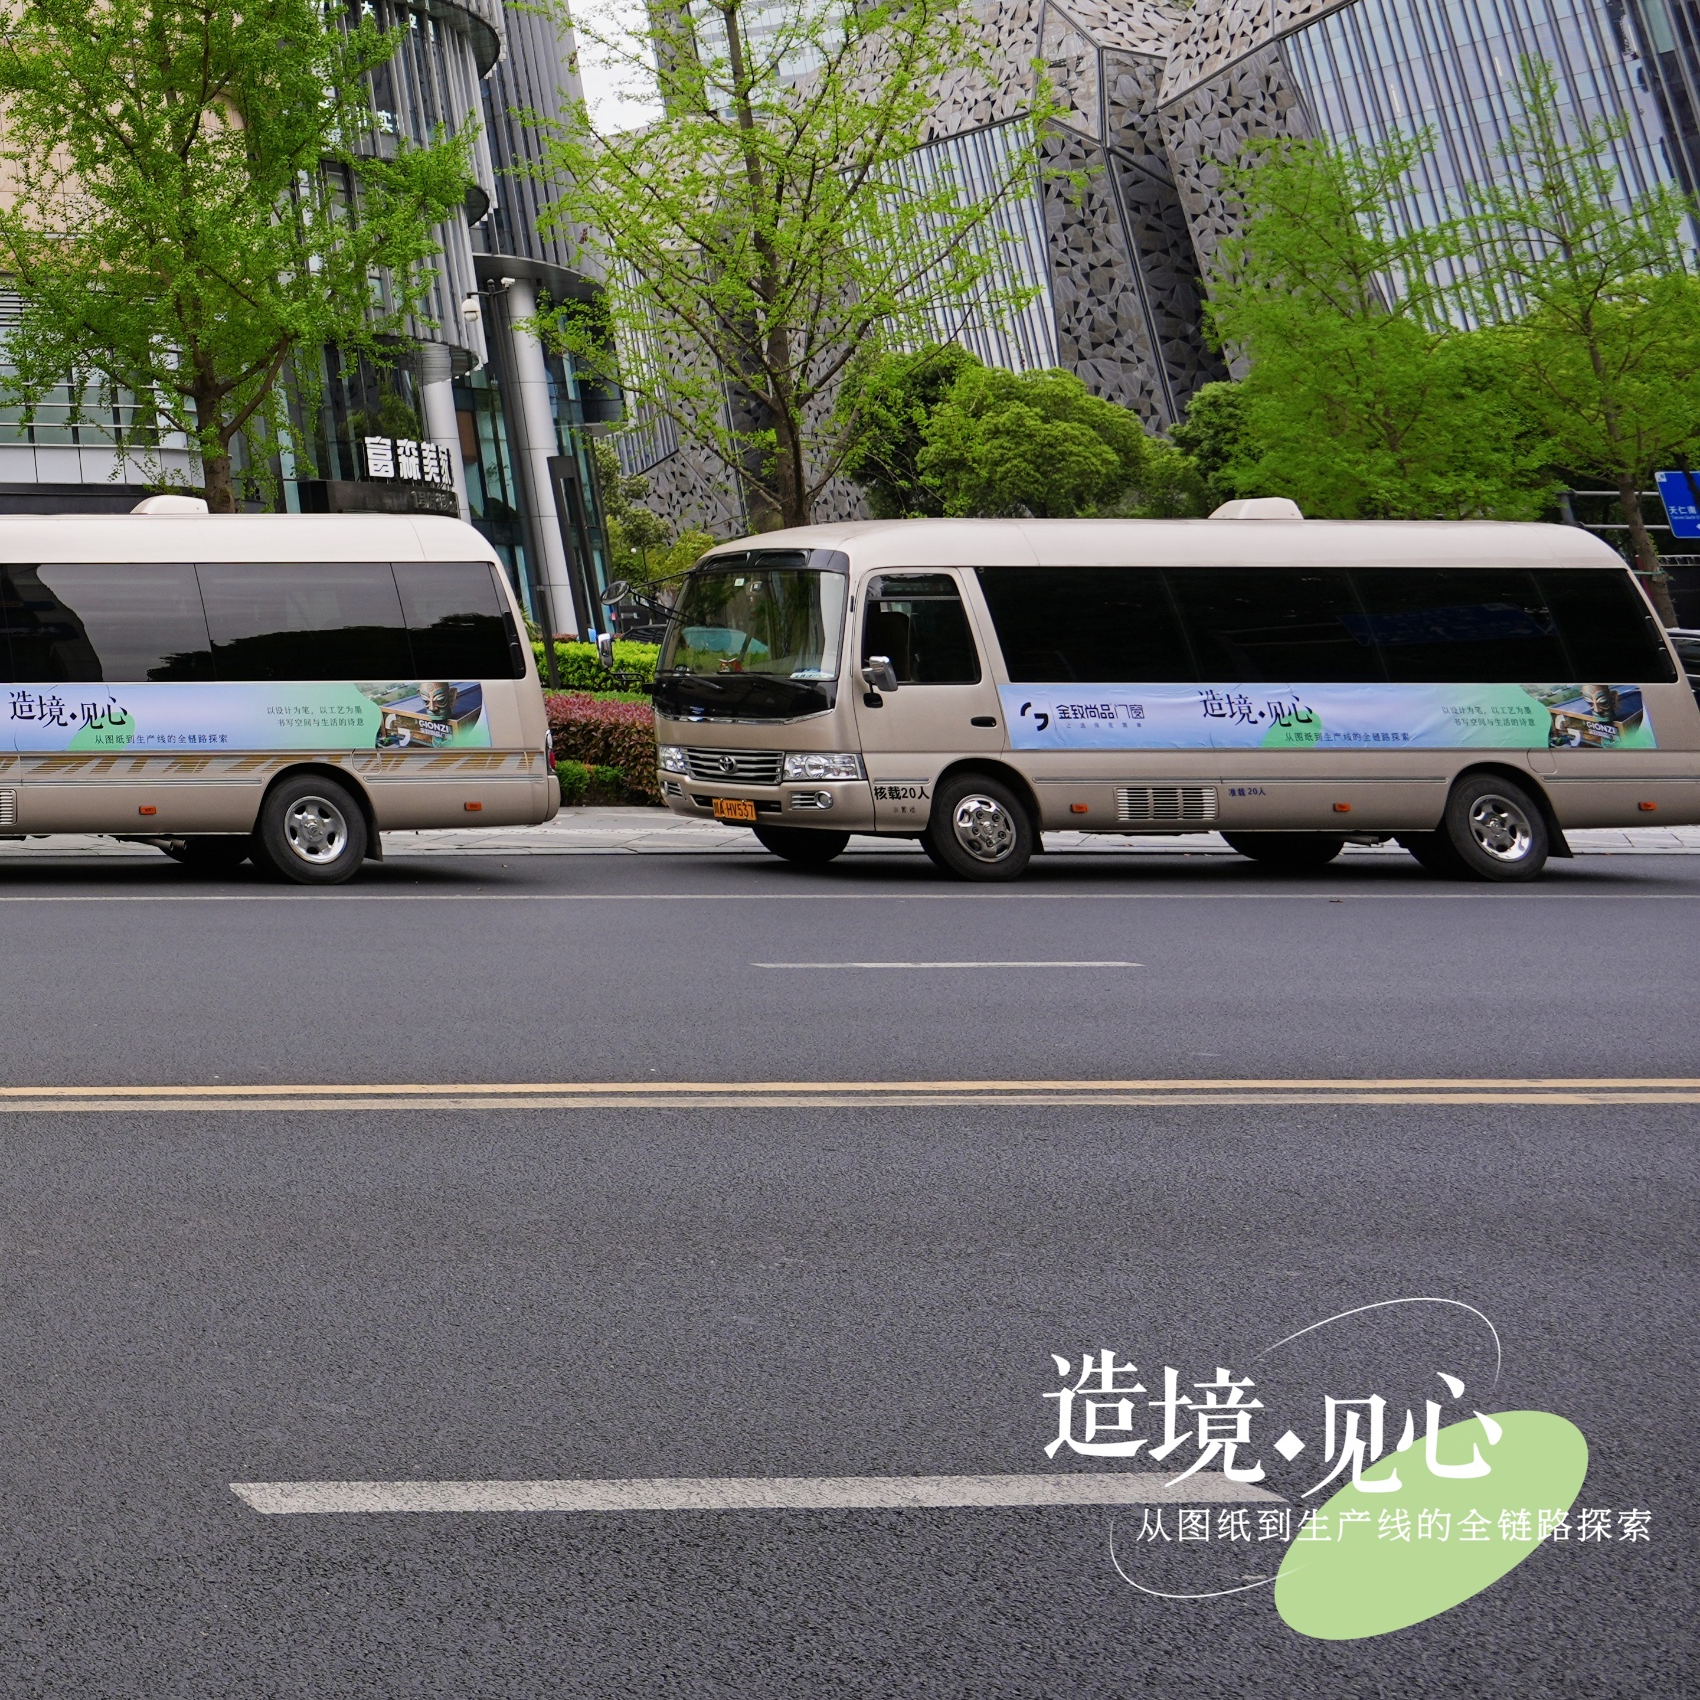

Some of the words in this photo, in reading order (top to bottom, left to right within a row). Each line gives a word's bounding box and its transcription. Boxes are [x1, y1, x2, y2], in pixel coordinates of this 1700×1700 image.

[277, 717, 365, 728] 书写空间与生活的诗意
[94, 733, 229, 745] 从图纸到生产线的全链路探索
[1285, 731, 1411, 743] 从图纸到生产线的全链路探索
[873, 785, 930, 800] 核载20人
